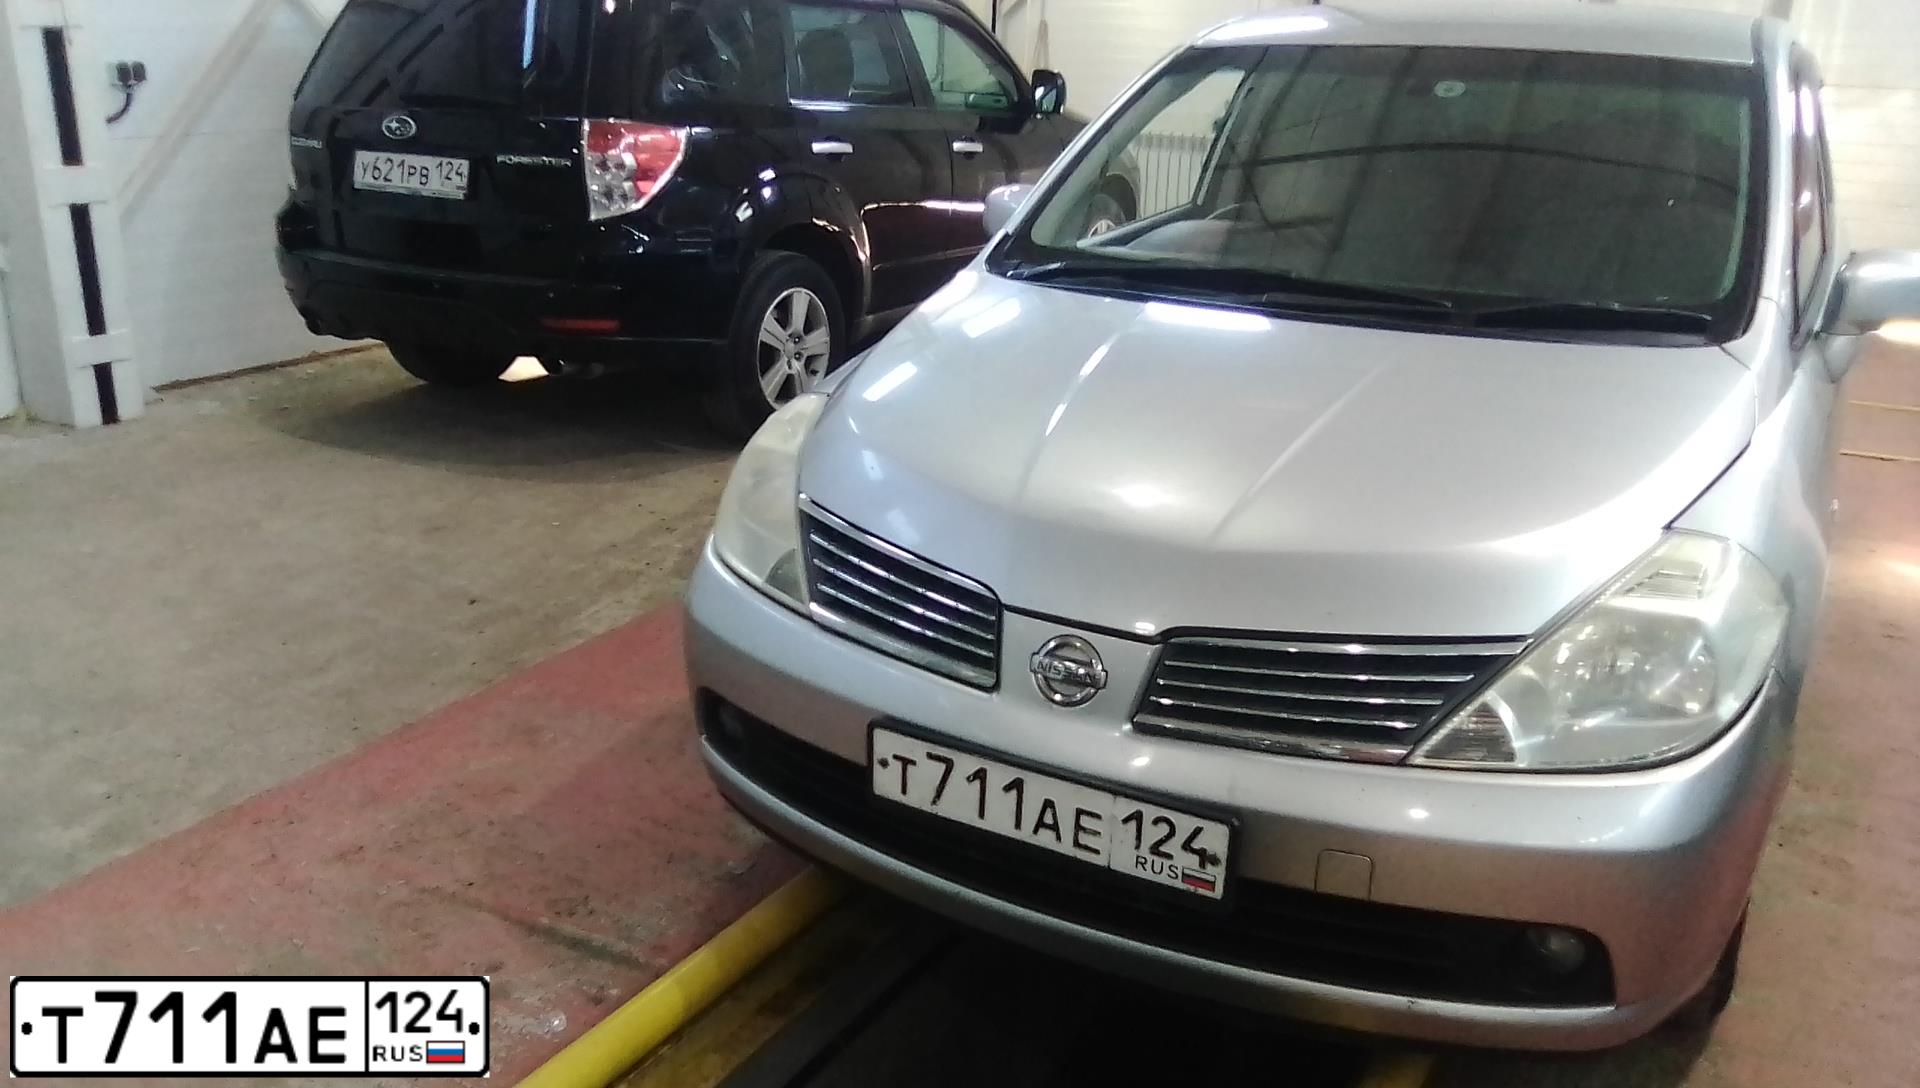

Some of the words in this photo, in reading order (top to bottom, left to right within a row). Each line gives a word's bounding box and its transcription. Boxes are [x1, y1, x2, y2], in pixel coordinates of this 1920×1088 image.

[435, 160, 466, 182] 124
[496, 155, 571, 168] FOTR
[892, 752, 1102, 855] Т711АЕ
[1121, 808, 1209, 870] 124
[1135, 855, 1180, 880] RUS
